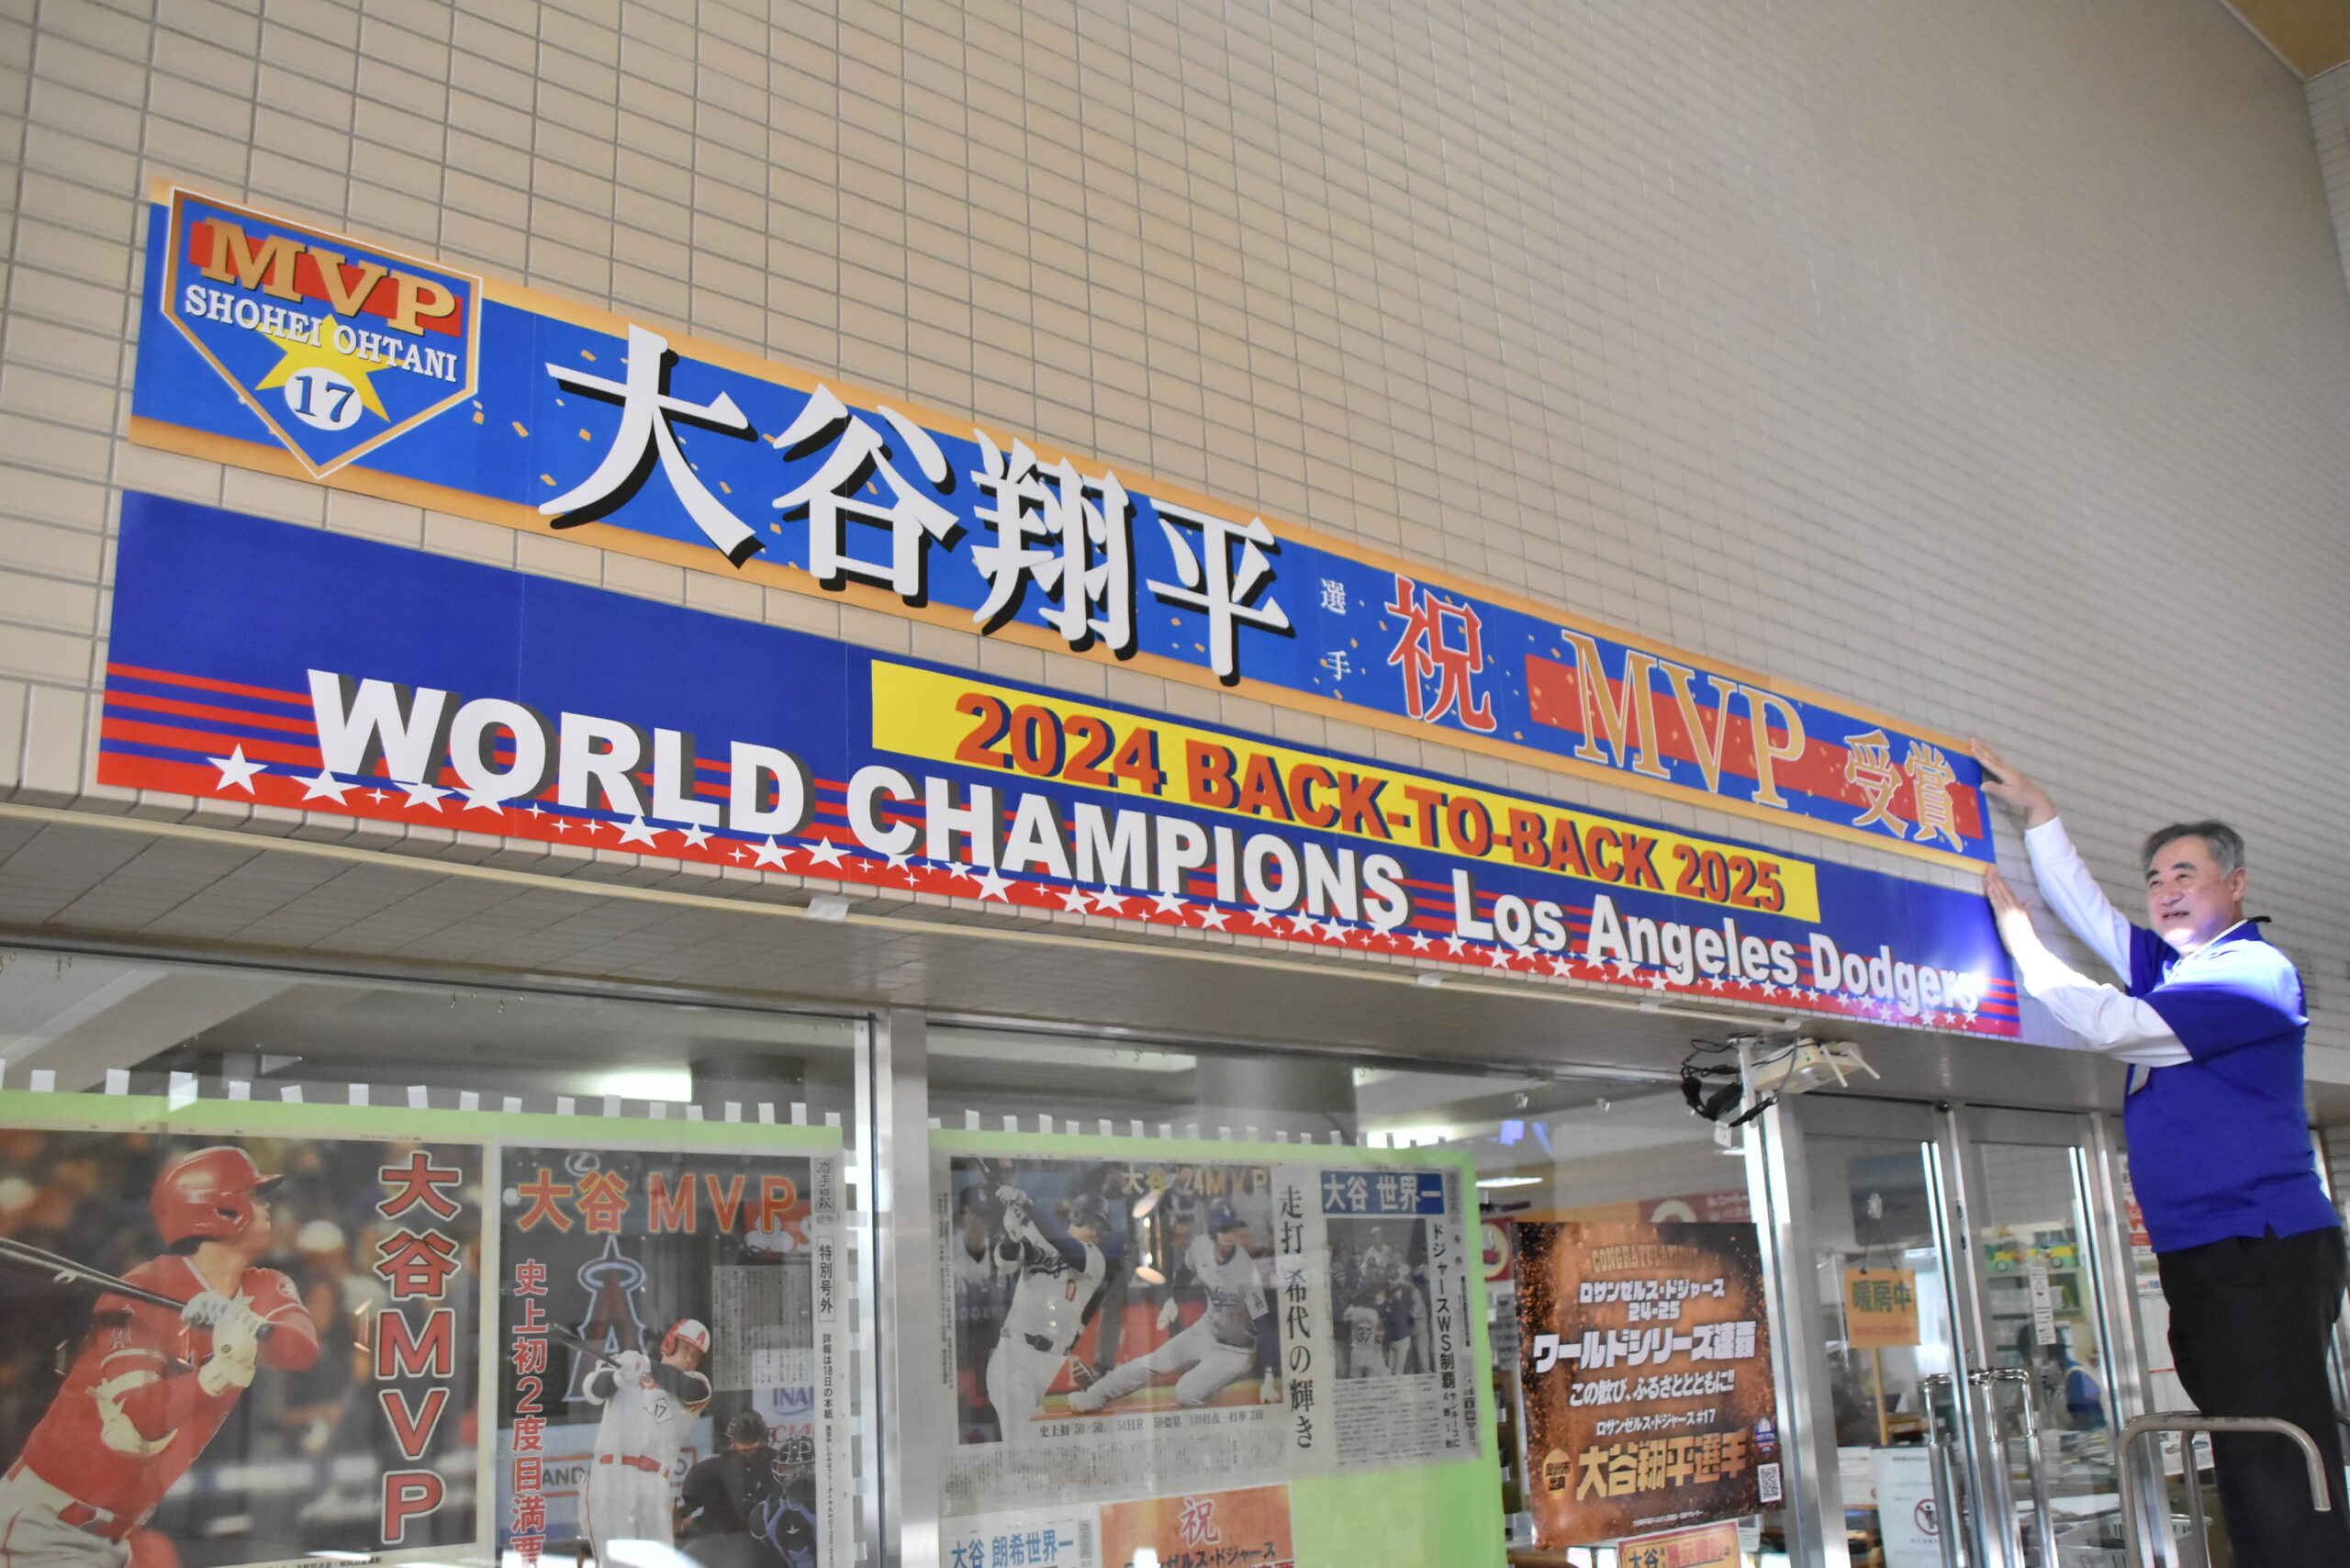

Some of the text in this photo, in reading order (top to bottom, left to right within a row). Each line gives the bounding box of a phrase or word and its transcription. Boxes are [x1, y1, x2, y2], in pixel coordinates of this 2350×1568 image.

[199, 217, 457, 336] MVP
[185, 285, 458, 384] SHOHEI OHTANI
[295, 374, 356, 423] 17
[539, 323, 1292, 679] 大谷翔平
[1321, 577, 1351, 681] 選手
[1386, 573, 1497, 733] 祝
[1561, 629, 1807, 809] MVP
[954, 692, 1784, 913] 2024 BACK-TO-BACK 2025
[1843, 729, 1964, 854] 受賞
[307, 668, 1983, 1018] WORLD CHAMPIONS Los Angeles Dodgers
[516, 1169, 798, 1234] 大谷 MVP
[1324, 1175, 1369, 1212] 大谷
[1376, 1175, 1442, 1213] 世界一
[819, 1244, 834, 1315] 特別号外
[1279, 1185, 1315, 1450] 走打 希代の輝き
[1579, 1279, 1725, 1304] ロサンゼルス・ドジャース
[1628, 1300, 1681, 1322] 24-25
[375, 1149, 462, 1545] 大谷MVP
[1533, 1320, 1757, 1374] ワールドシリーズ連覇
[1576, 1428, 1746, 1501] 大谷翔平選手
[991, 1529, 1074, 1566] 朗希世界一
[1181, 1497, 1221, 1546] 祝
